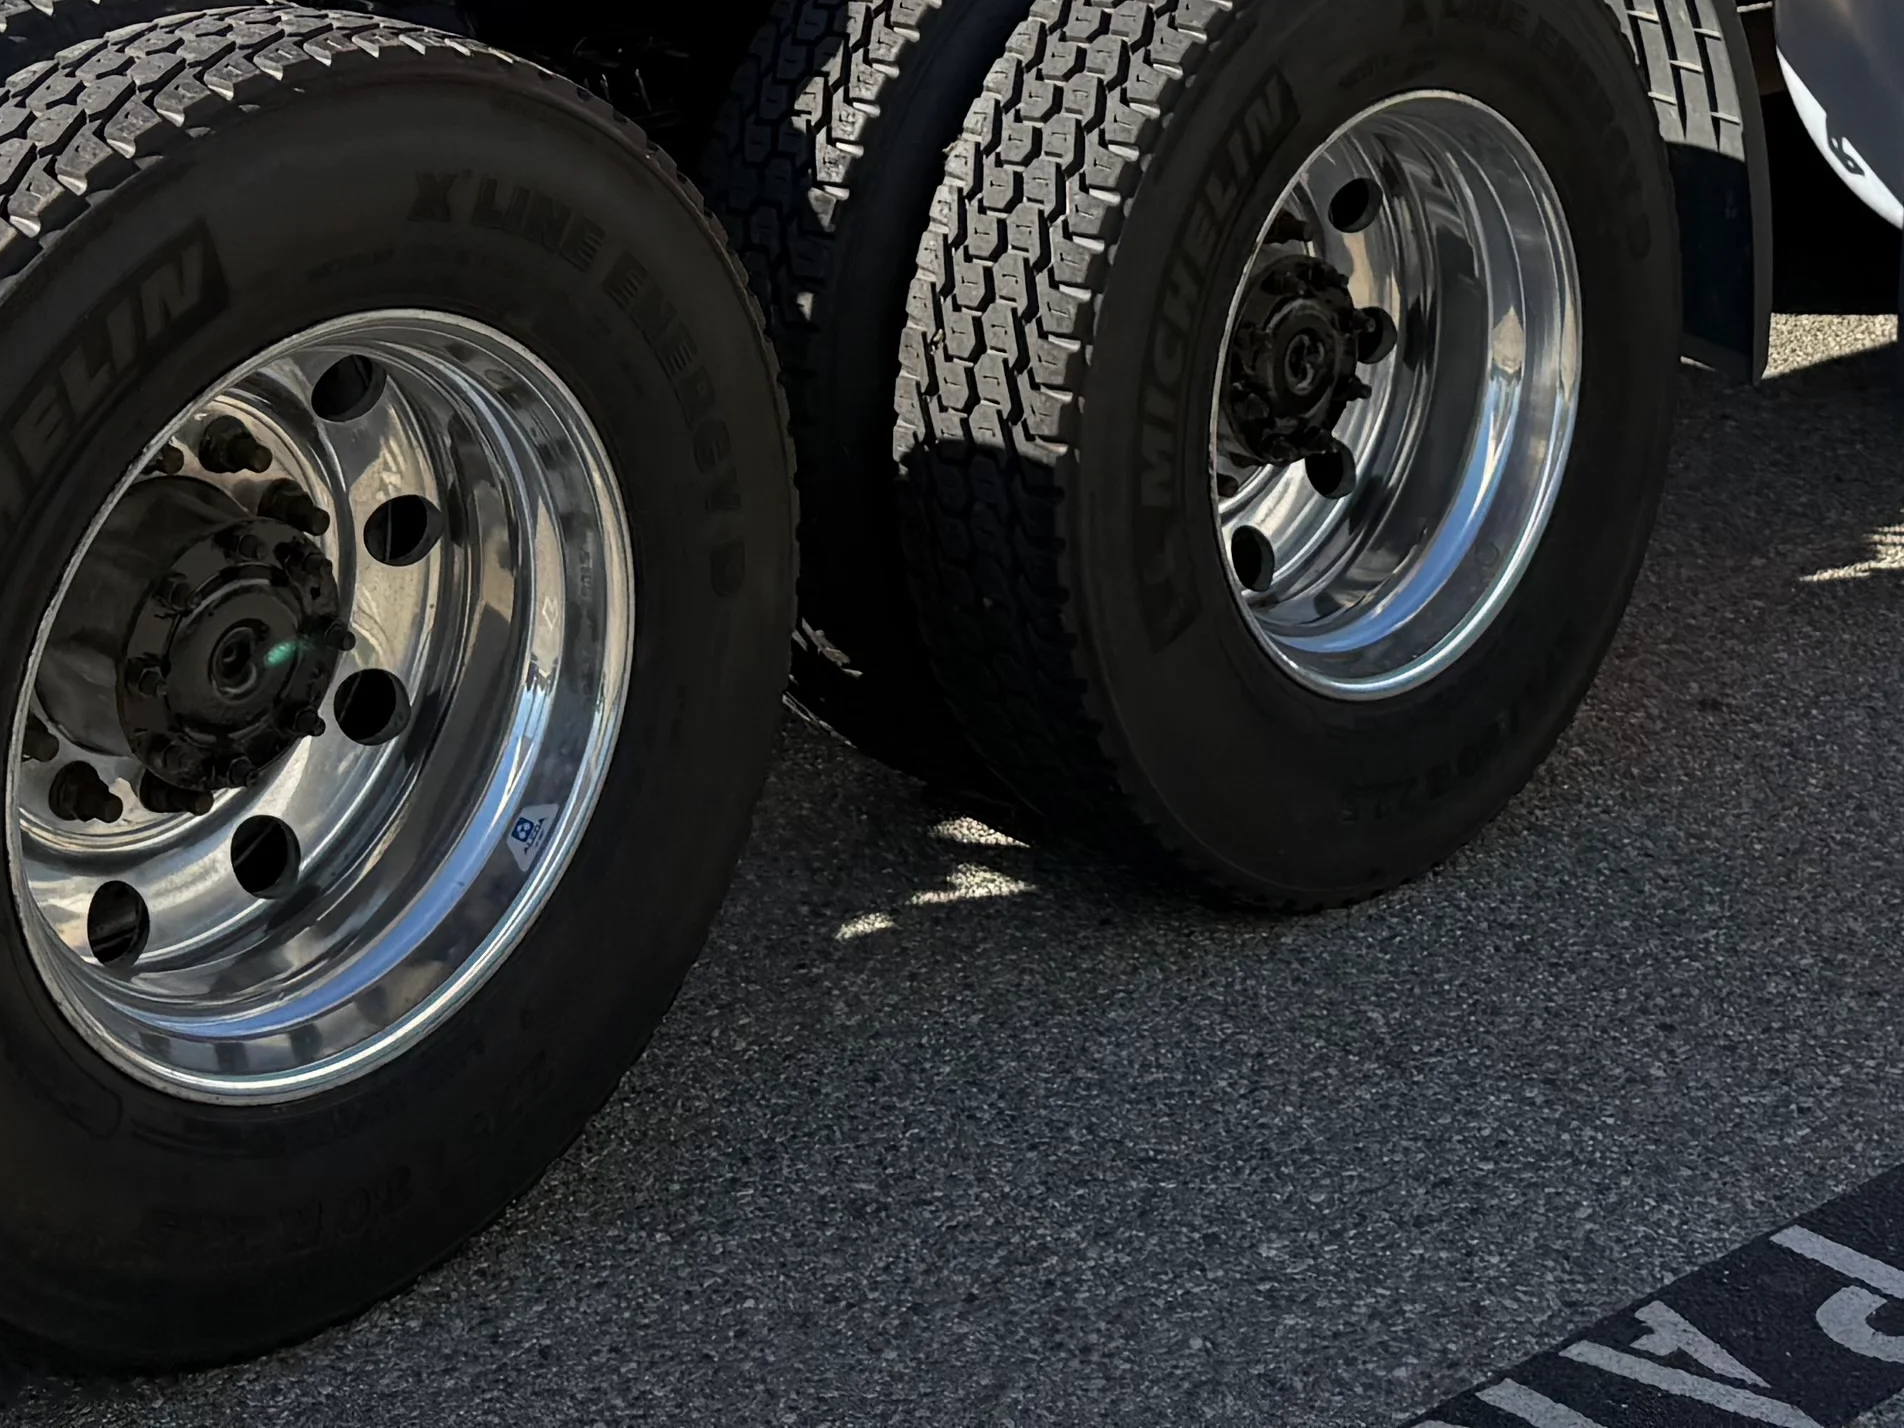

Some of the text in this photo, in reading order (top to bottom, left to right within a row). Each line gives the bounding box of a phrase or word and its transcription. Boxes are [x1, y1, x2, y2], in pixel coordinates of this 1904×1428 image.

[471, 173, 607, 274] LINE
[600, 250, 743, 513] ENERGY
[1139, 77, 1287, 503] MICHELIN
